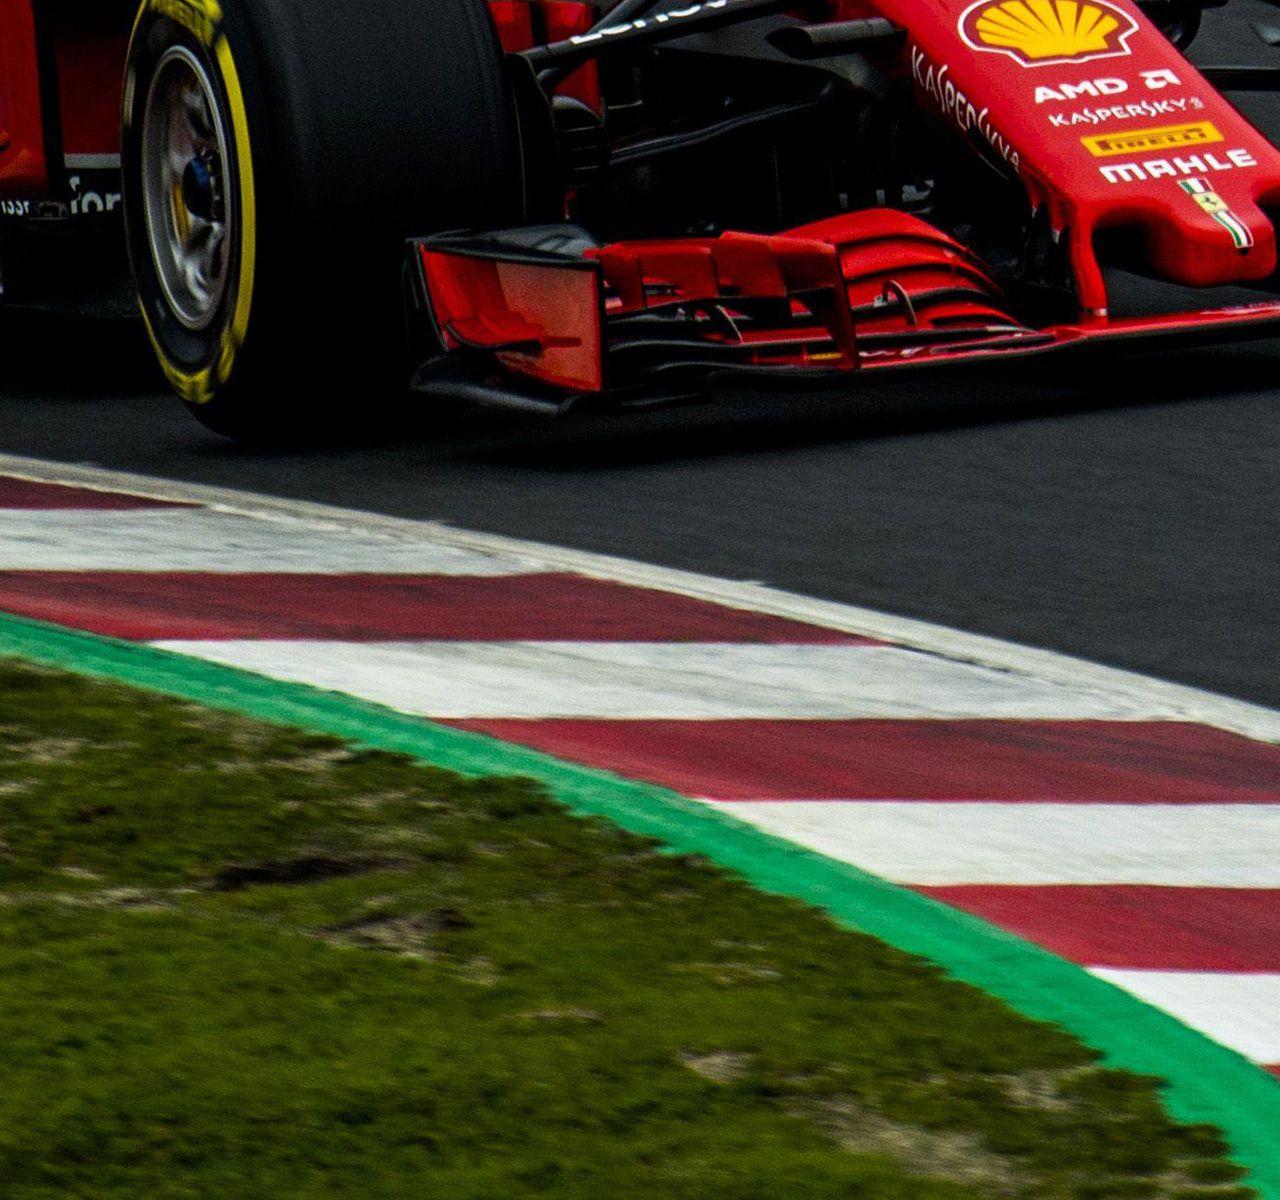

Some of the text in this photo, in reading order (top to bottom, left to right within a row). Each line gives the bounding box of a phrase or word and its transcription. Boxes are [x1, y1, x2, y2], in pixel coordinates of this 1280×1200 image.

[1034, 77, 1129, 103] AMD
[1048, 97, 1187, 127] KASPERSKY
[1099, 148, 1258, 184] MAHLE
